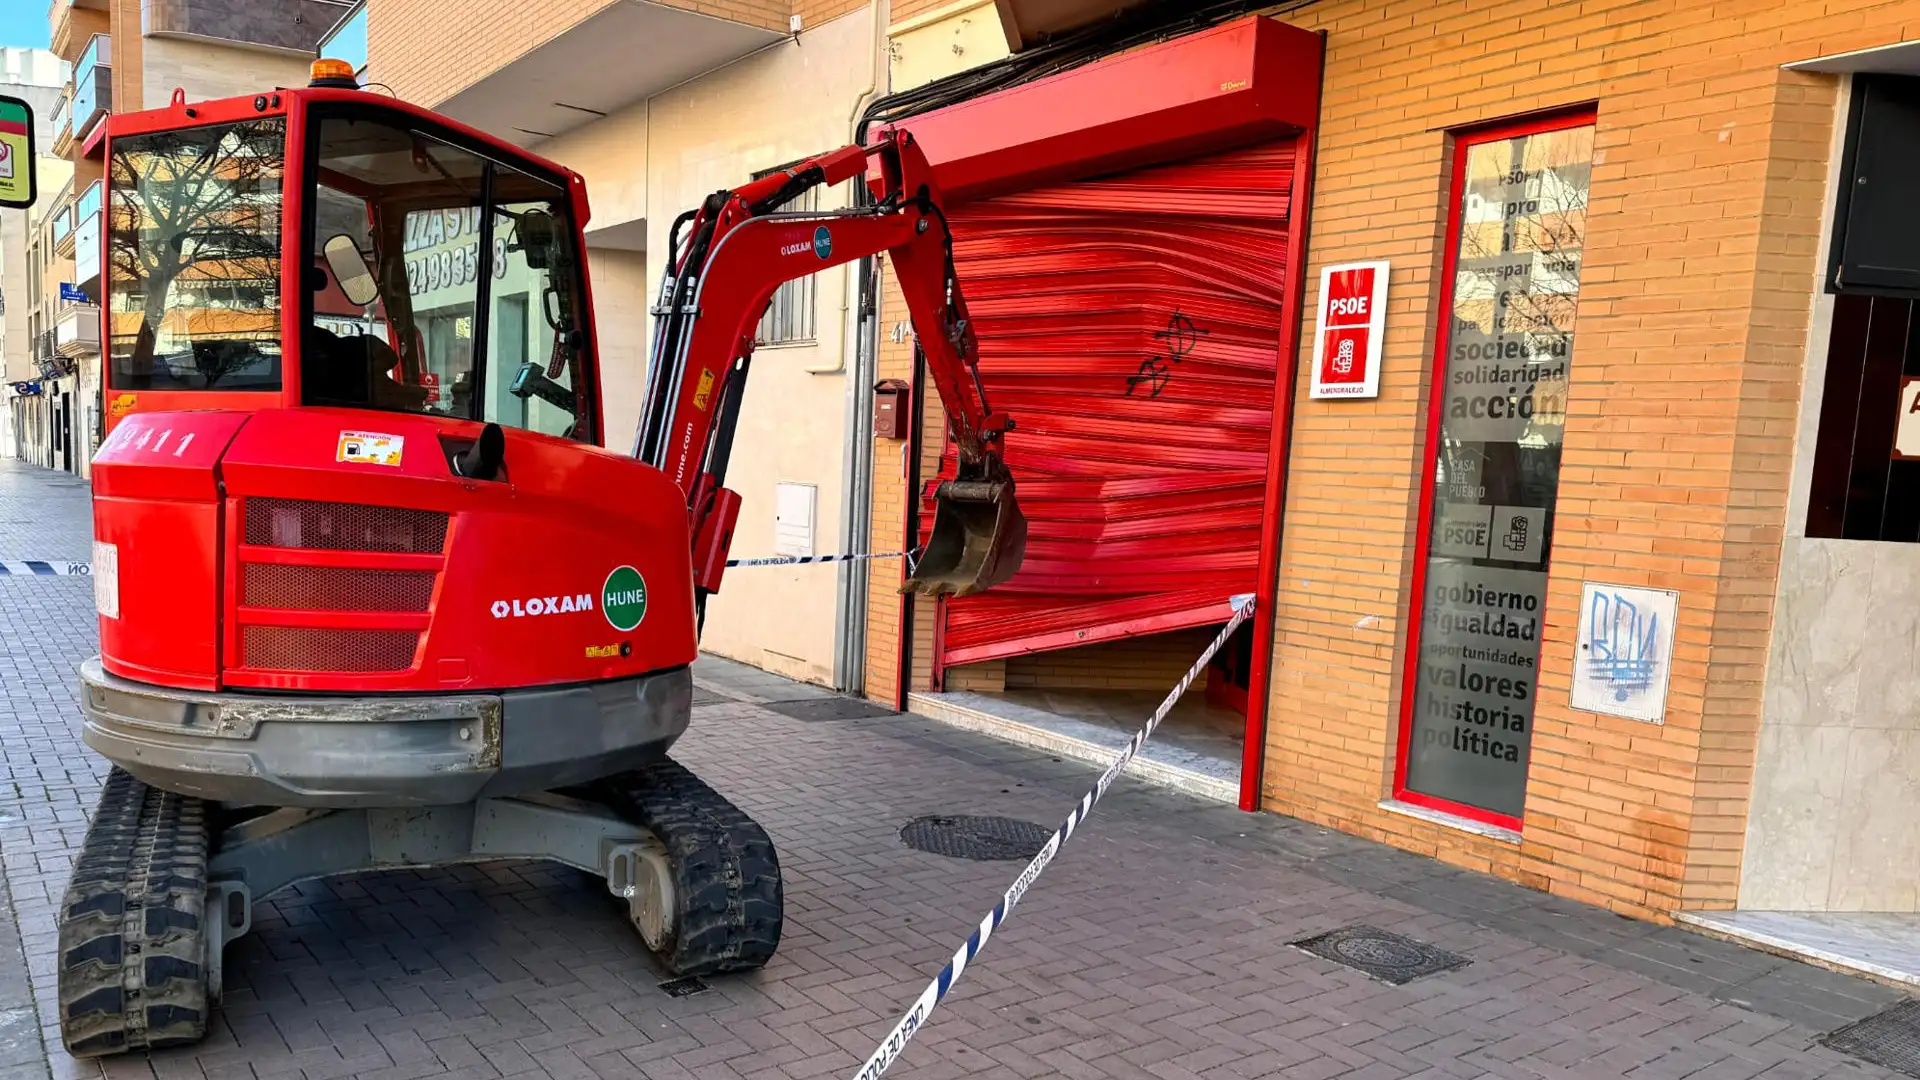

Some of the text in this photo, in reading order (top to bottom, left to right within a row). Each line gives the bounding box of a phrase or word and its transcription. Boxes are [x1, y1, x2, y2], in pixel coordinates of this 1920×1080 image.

[786, 240, 812, 255] LOXAM
[1329, 296, 1369, 317] PSOE
[1453, 362, 1565, 385] solidaridad
[1449, 383, 1560, 420] acción
[1444, 528, 1487, 547] PSOE
[512, 588, 644, 617] LOXAM HUNE
[1434, 581, 1538, 612] gobierno
[1430, 643, 1534, 668] oportunidades
[1428, 663, 1528, 700] valores
[1427, 691, 1525, 733] historia
[1422, 725, 1519, 763] política
